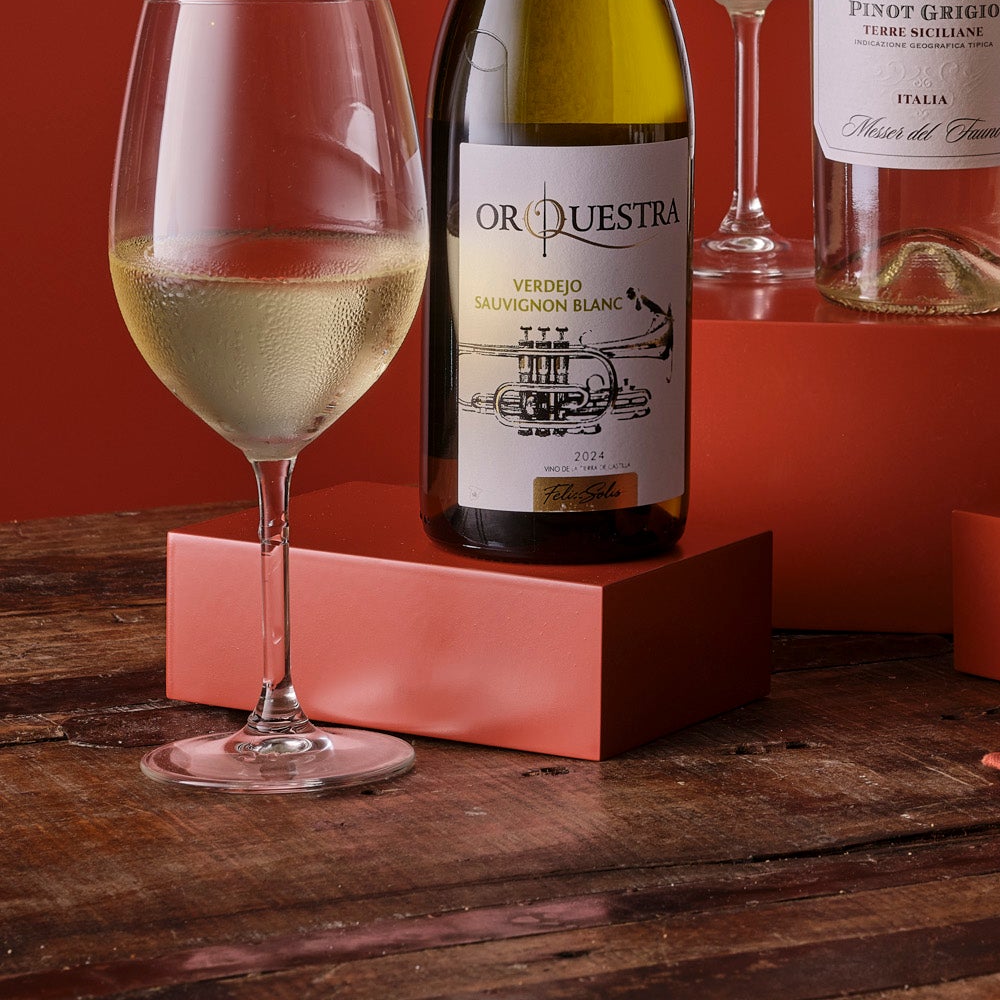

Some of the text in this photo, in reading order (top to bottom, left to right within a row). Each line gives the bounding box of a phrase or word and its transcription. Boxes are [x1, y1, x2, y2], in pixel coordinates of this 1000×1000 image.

[849, 0, 1000, 21] PINOT GRIGIO
[863, 24, 984, 38] TERRE SICILIANE
[854, 39, 907, 49] INDICAZIONE
[897, 94, 948, 105] ITALIA
[841, 114, 903, 141] Messer
[906, 122, 942, 141] del
[476, 198, 680, 249] ORQUESTRA
[513, 278, 582, 296] VERDEJO
[475, 295, 623, 312] SAUVIGNON BLANC
[574, 451, 604, 461] 2024
